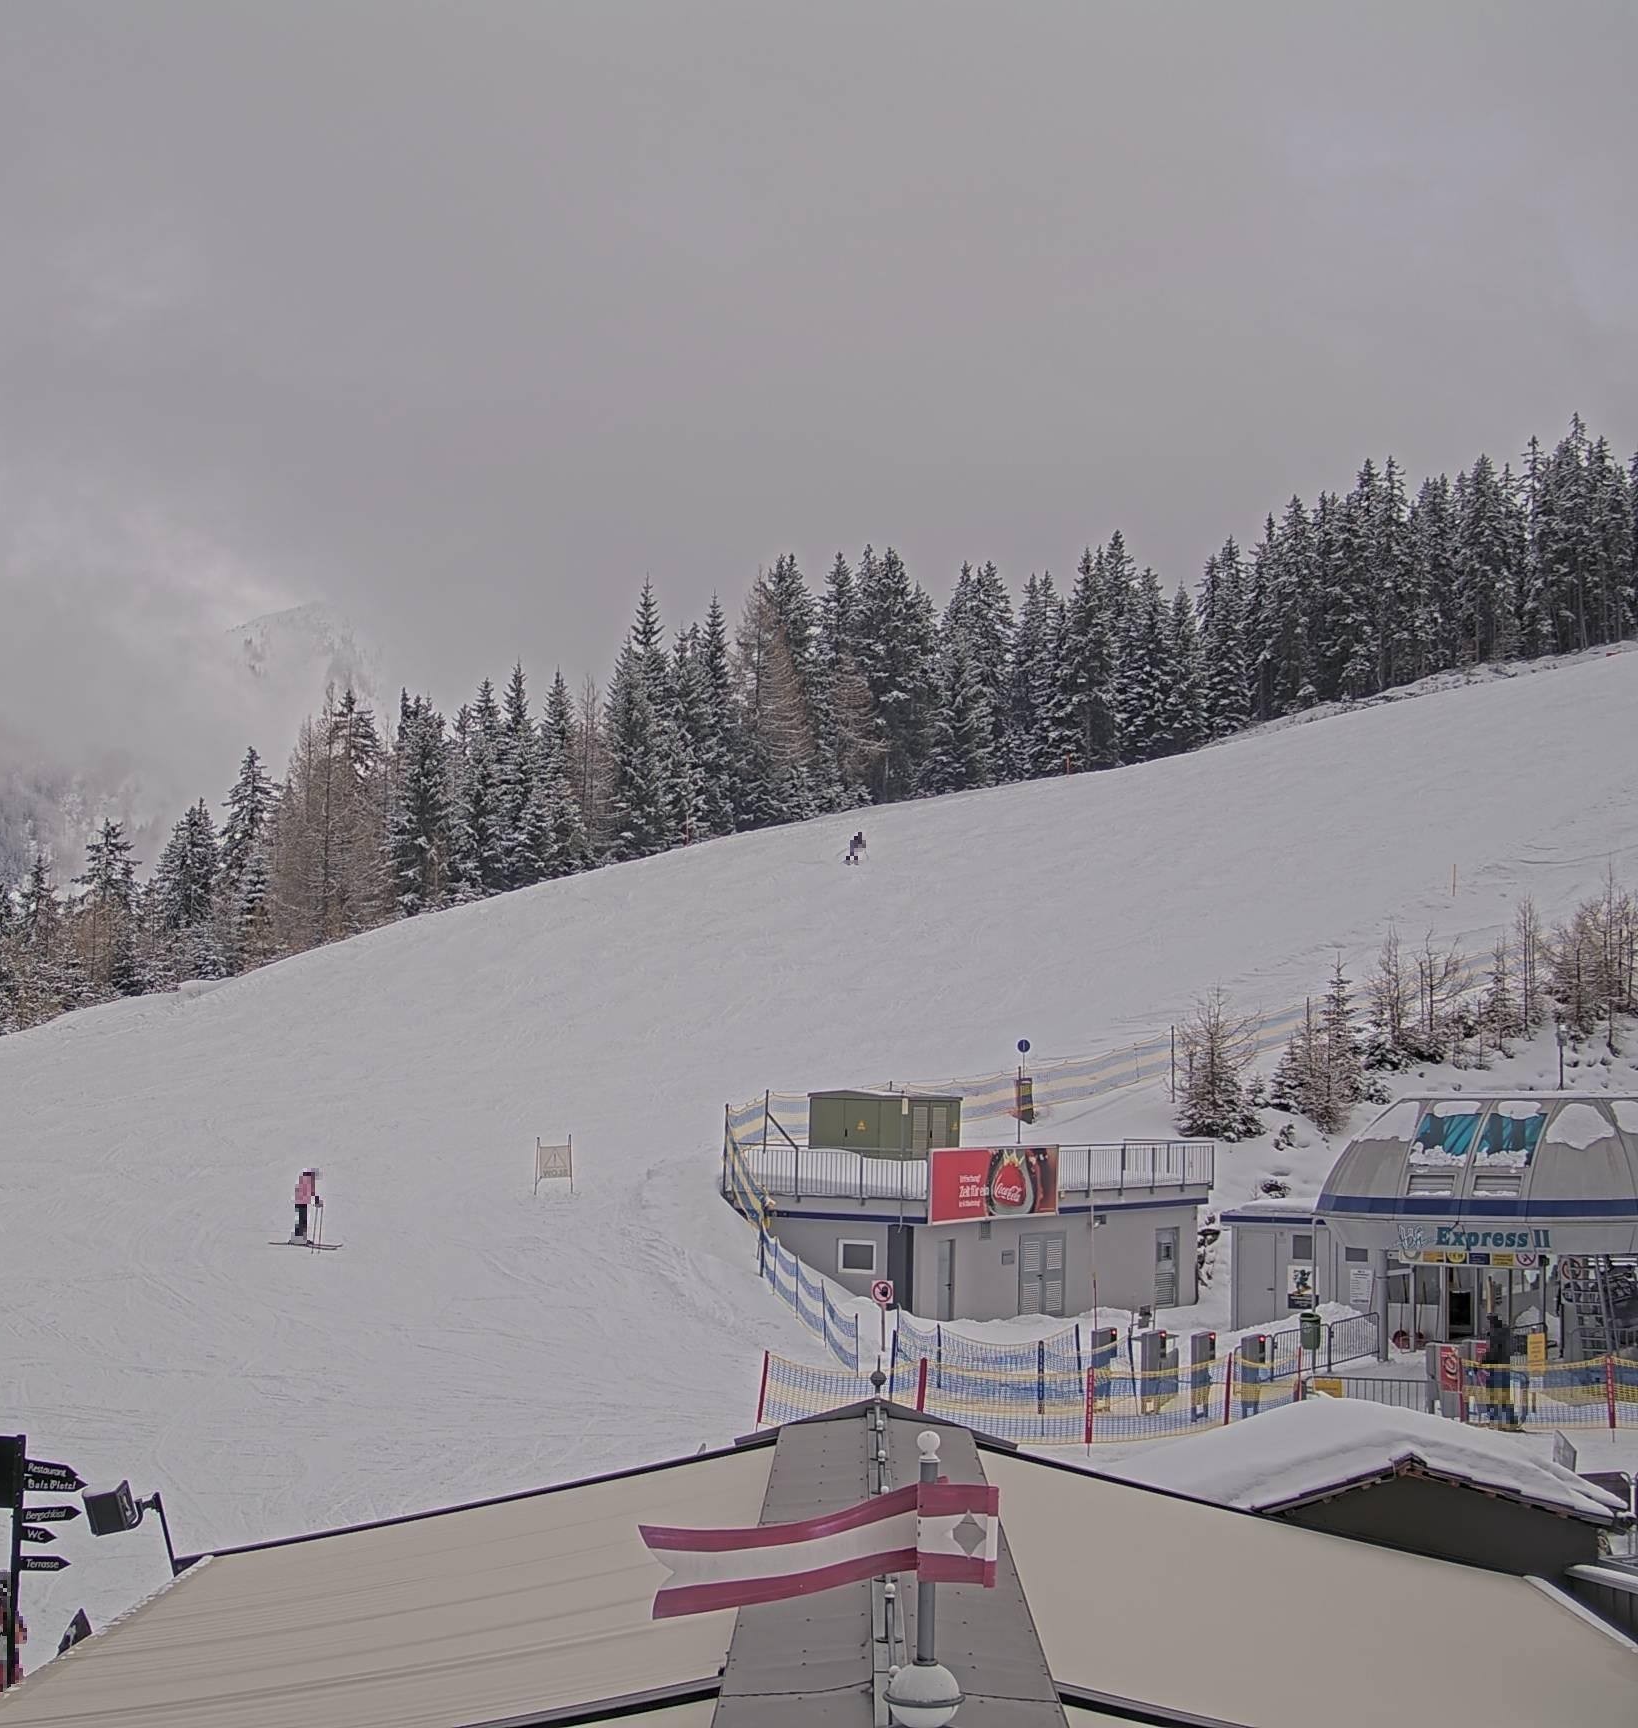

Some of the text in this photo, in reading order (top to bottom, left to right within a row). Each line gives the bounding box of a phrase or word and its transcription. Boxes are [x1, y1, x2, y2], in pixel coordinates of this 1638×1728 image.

[1436, 1226, 1529, 1250] Express
[28, 1462, 67, 1477] Restaurant
[27, 1529, 46, 1540] WC
[26, 1559, 60, 1569] Terrasse
